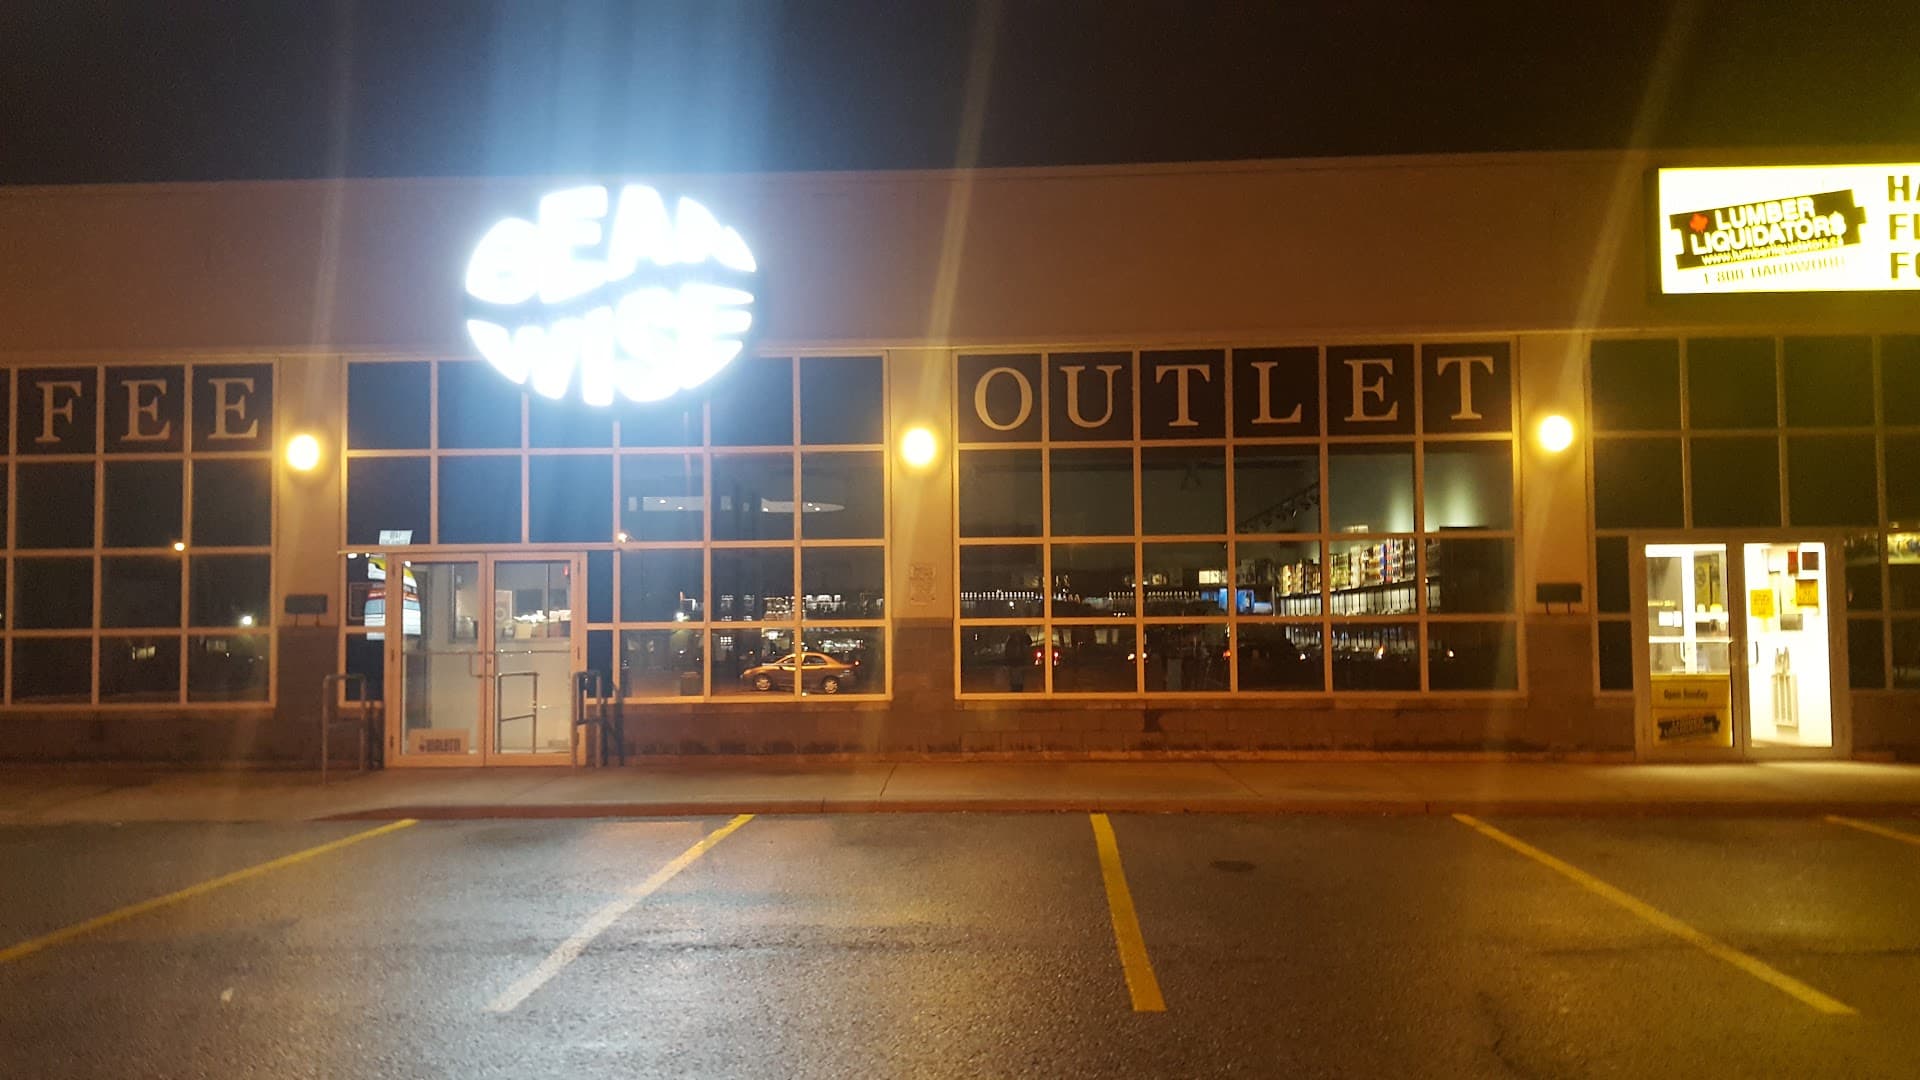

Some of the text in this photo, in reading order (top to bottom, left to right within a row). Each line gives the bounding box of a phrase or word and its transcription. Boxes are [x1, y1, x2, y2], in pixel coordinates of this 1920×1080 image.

[1888, 175, 1920, 201] H
[1714, 196, 1816, 231] LUMBER
[1889, 213, 1920, 240] F
[467, 186, 756, 304] BEAN
[1890, 252, 1920, 279] F
[467, 284, 755, 406] WISE
[34, 377, 259, 443] FEE
[974, 356, 1494, 431] OUTLET
